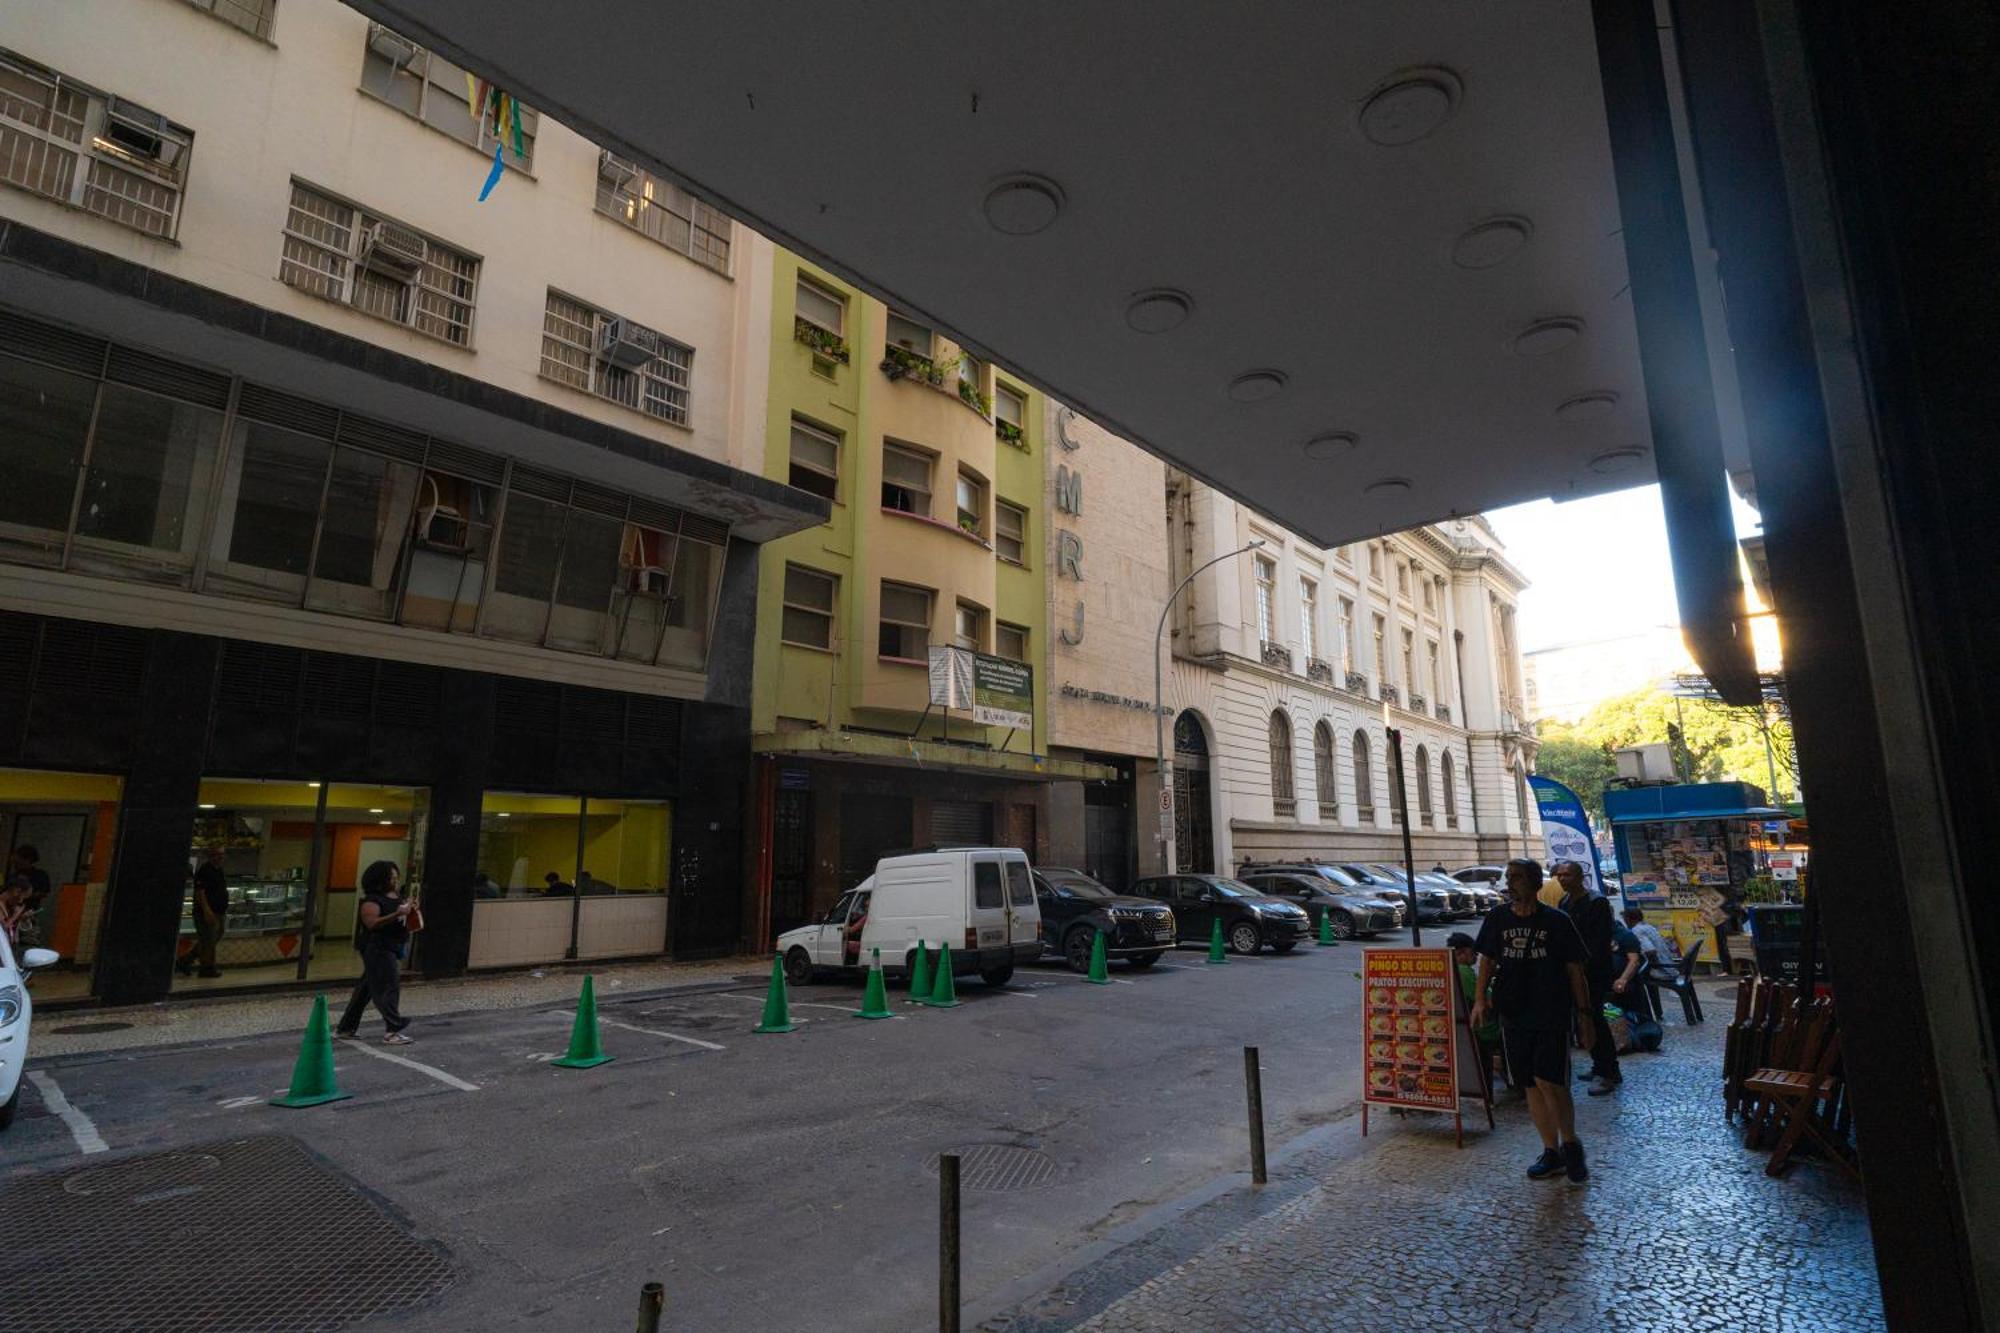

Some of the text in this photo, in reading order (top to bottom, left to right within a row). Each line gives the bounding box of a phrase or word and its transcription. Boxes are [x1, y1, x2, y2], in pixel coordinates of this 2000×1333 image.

[1369, 960, 1445, 972] PINGO DE OURO
[1369, 976, 1446, 988] PRATOS EXECUTIVOS
